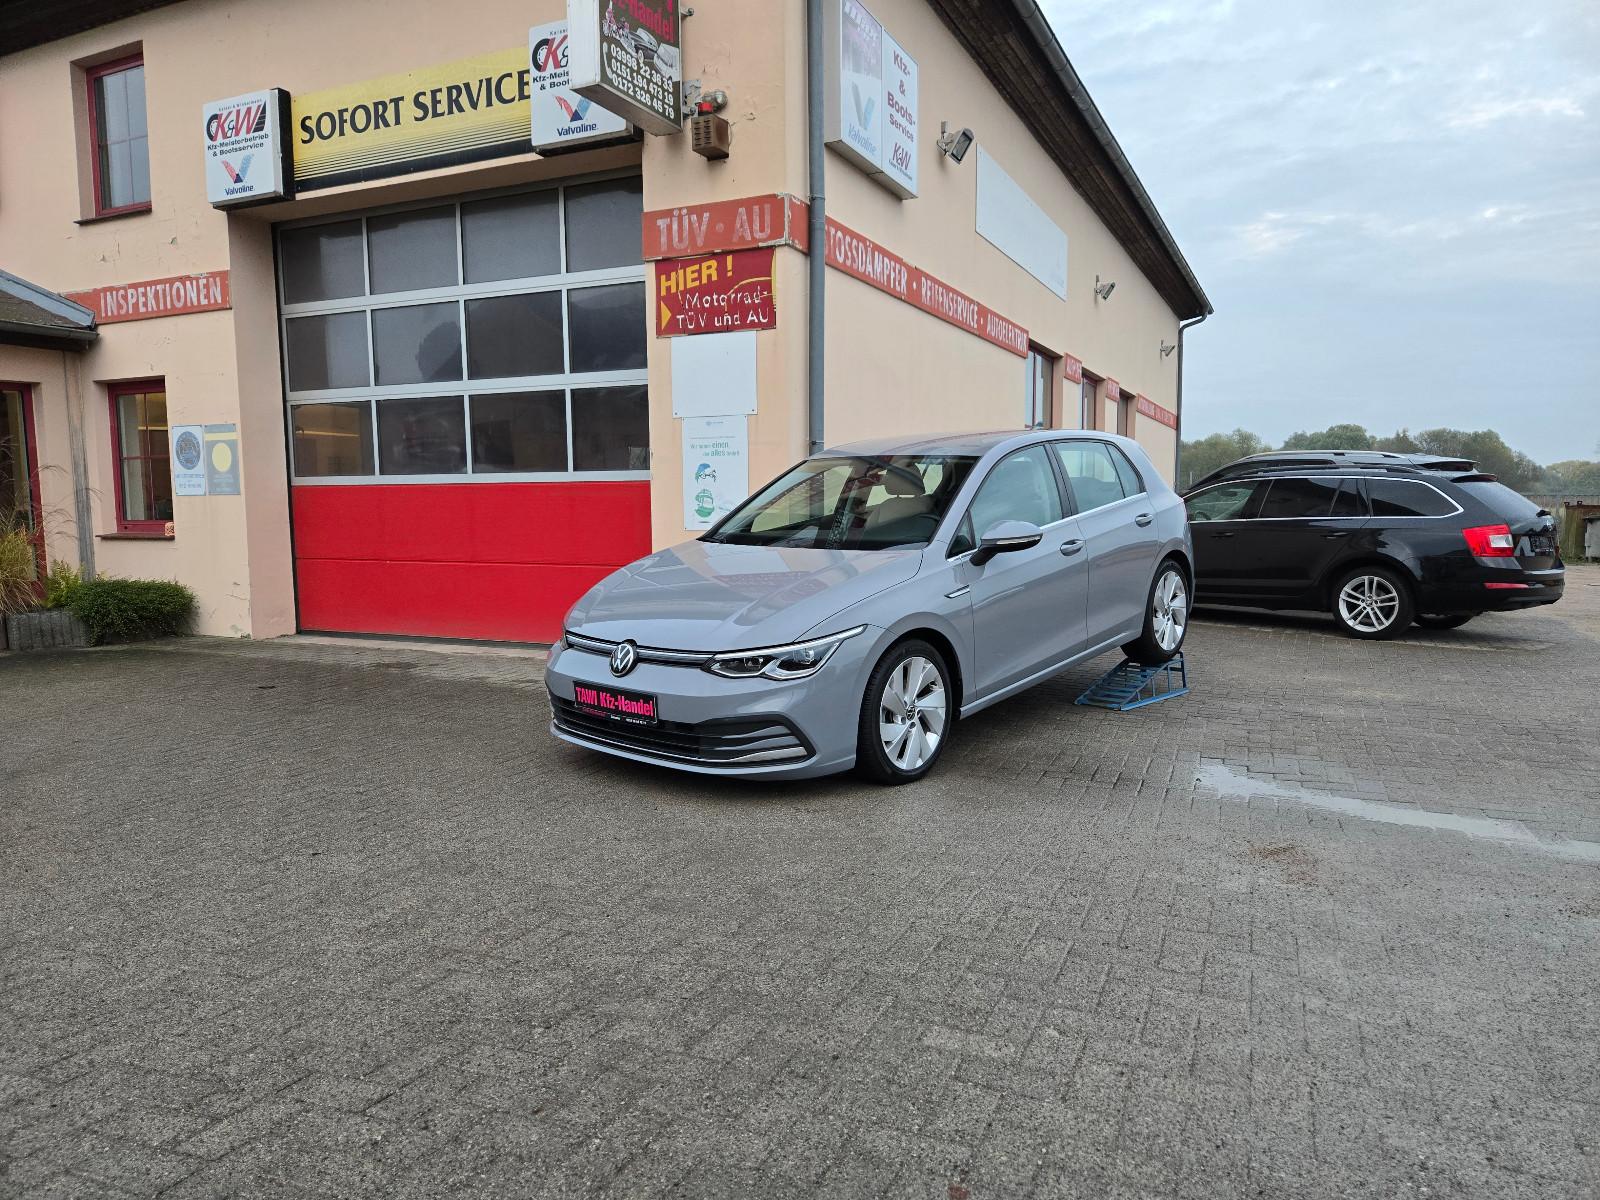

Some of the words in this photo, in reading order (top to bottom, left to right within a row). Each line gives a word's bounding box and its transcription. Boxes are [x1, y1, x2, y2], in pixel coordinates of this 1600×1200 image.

[611, 44, 637, 70] 03998
[533, 70, 569, 84] Kfz-Meis
[550, 80, 569, 89] Boot
[612, 58, 631, 81] 0151
[633, 72, 647, 90] 194
[649, 82, 662, 100] 473
[664, 91, 673, 106] 19
[899, 80, 906, 97] &
[300, 96, 404, 144] SOFORT
[413, 69, 530, 122] SERVICE
[612, 73, 634, 96] 0172
[635, 87, 651, 106] 326
[664, 104, 674, 119] 79
[207, 133, 269, 151] Kfz-Meisterbetrieb
[557, 123, 597, 136] Valvoline
[889, 113, 914, 143] Service
[220, 142, 264, 156] Bootsservice
[224, 184, 254, 196] Valvoline
[656, 208, 710, 251] TÜV
[732, 203, 771, 242] AU
[661, 260, 718, 297] HIER
[825, 224, 907, 296] TOSSDÄMPFER
[921, 276, 978, 328] REIFENSERVICE
[100, 276, 222, 318] INSPEKTIONEN
[676, 311, 707, 329] TÜV
[714, 311, 741, 326] und
[746, 307, 769, 324] AU
[576, 687, 598, 706] TAWI
[600, 691, 654, 717] Kfz-Handel
